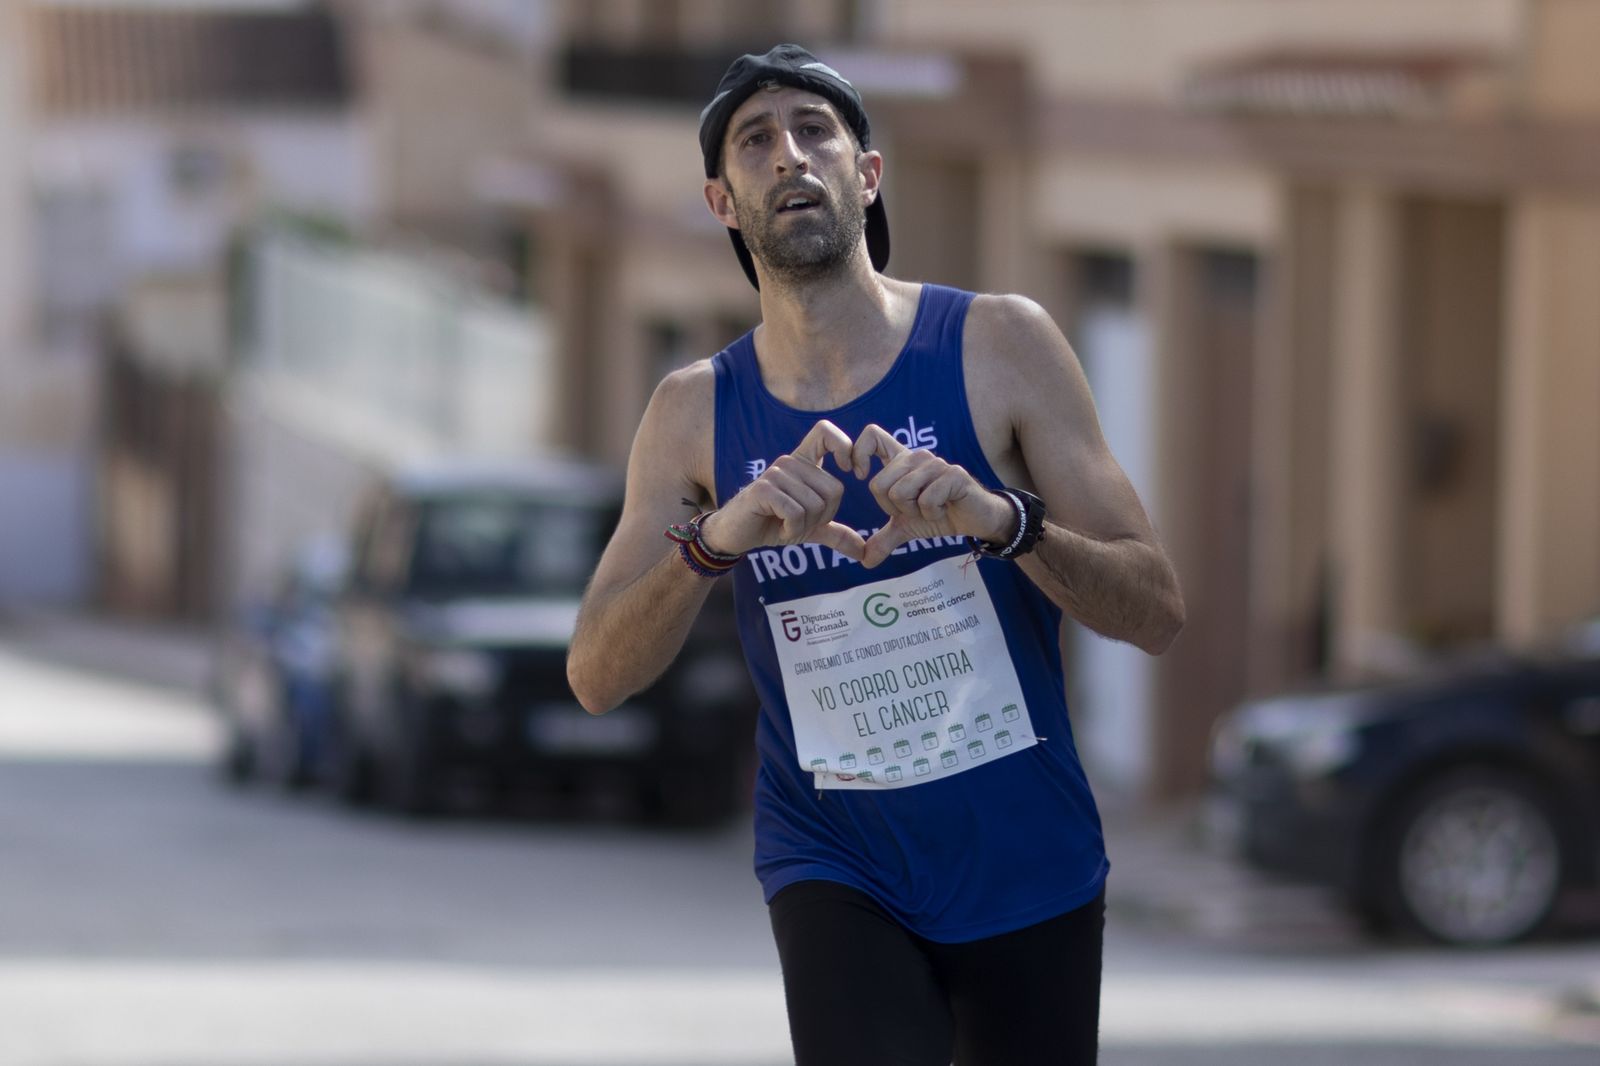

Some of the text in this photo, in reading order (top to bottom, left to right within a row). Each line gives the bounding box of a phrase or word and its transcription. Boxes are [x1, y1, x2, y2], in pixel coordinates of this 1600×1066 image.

[899, 579, 944, 598] asociación
[903, 591, 943, 608] española
[907, 590, 976, 618] contra el cáncer
[800, 609, 845, 625] Diputación
[804, 619, 848, 635] de Granada
[794, 662, 813, 675] GRAN
[814, 654, 842, 671] PREMIO
[843, 650, 855, 663] DE
[855, 643, 883, 660] FONDO
[931, 626, 944, 640] DE
[944, 614, 981, 637] GRANADA
[811, 649, 974, 712] YO CORRO CONTRA
[853, 690, 950, 737] EL CÁNCER
